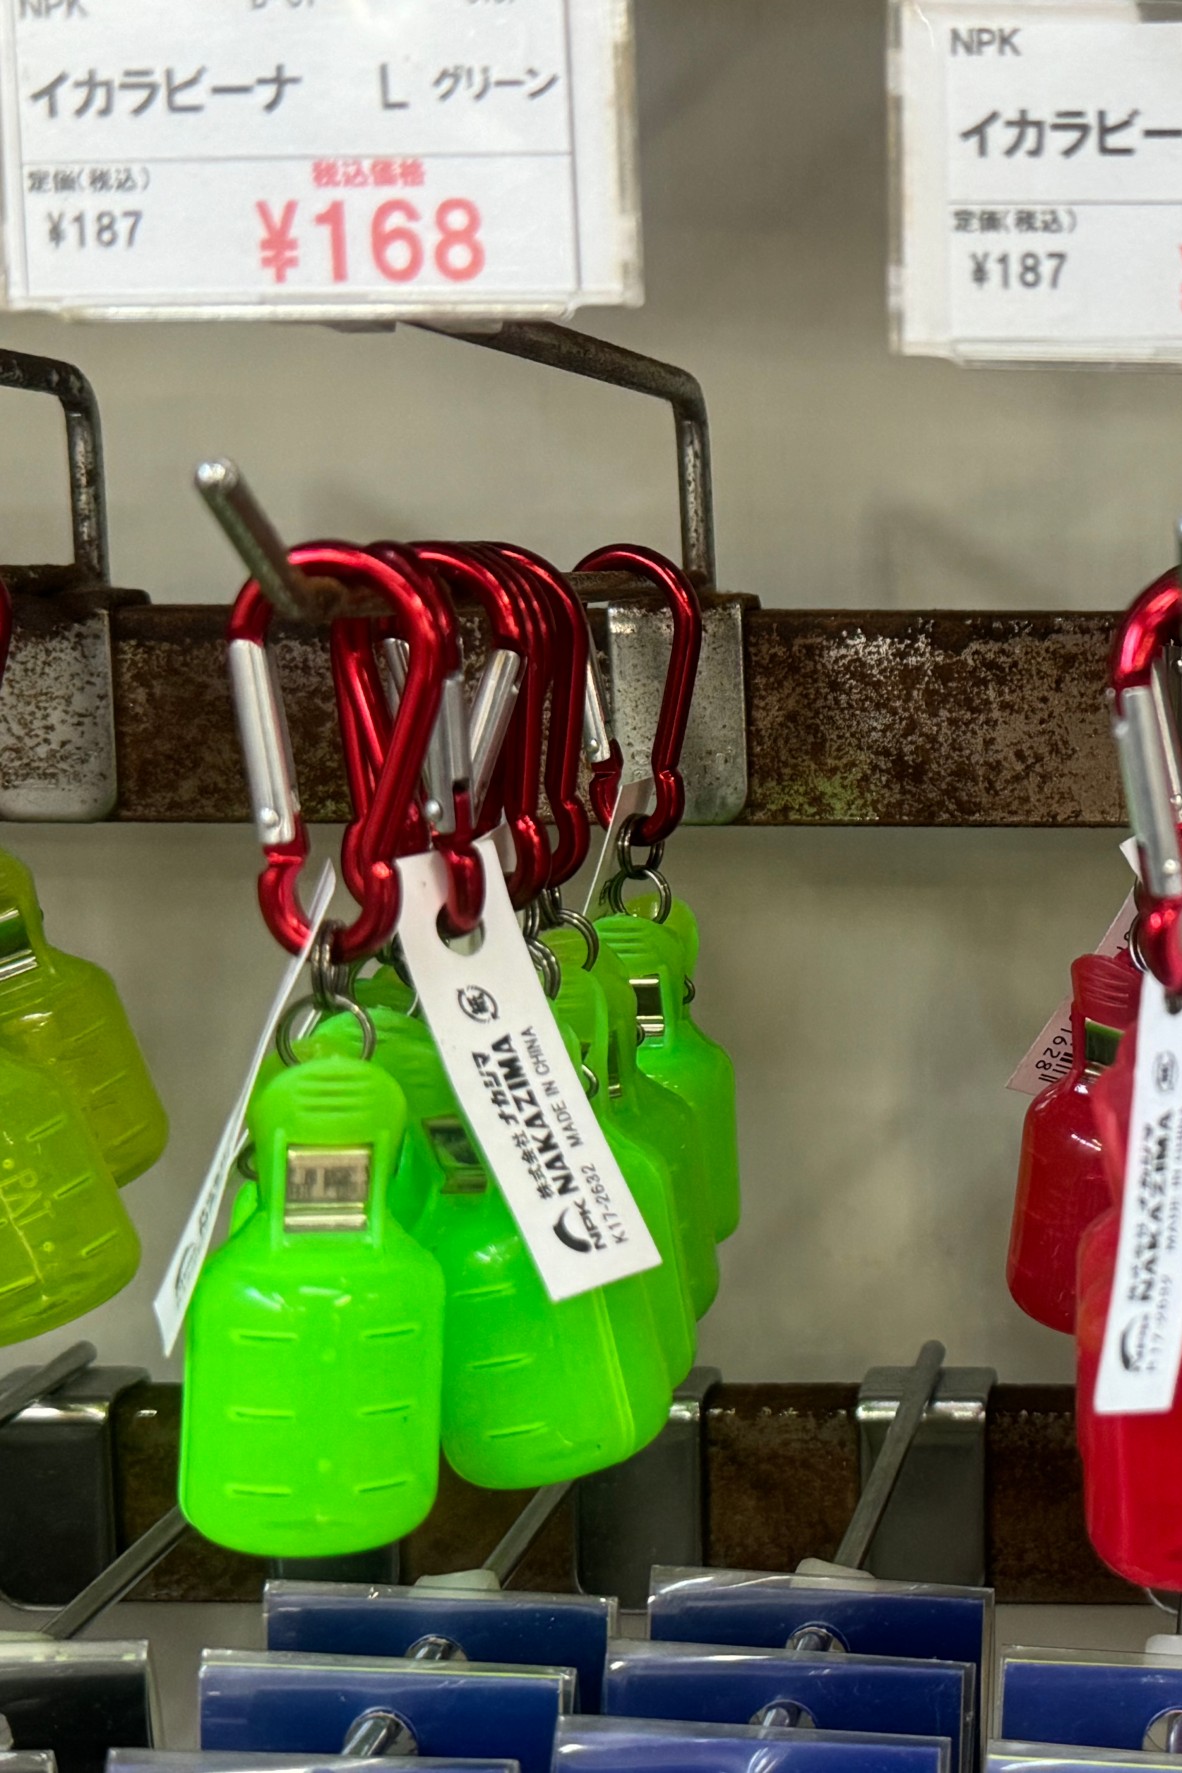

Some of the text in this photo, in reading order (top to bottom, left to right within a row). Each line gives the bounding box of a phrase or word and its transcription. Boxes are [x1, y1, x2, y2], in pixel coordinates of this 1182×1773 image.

[949, 28, 1021, 56] NPK
[29, 64, 562, 118] イカラビーナ L グリーン
[312, 160, 426, 188] 税込価格
[47, 210, 143, 249] ¥187
[256, 197, 487, 283] ¥168
[970, 252, 1068, 290] ¥187
[491, 1034, 579, 1198] NAKAZIMA
[520, 1026, 627, 1244] K17-2632 MADE IN CHINA
[575, 1197, 606, 1250] NPK
